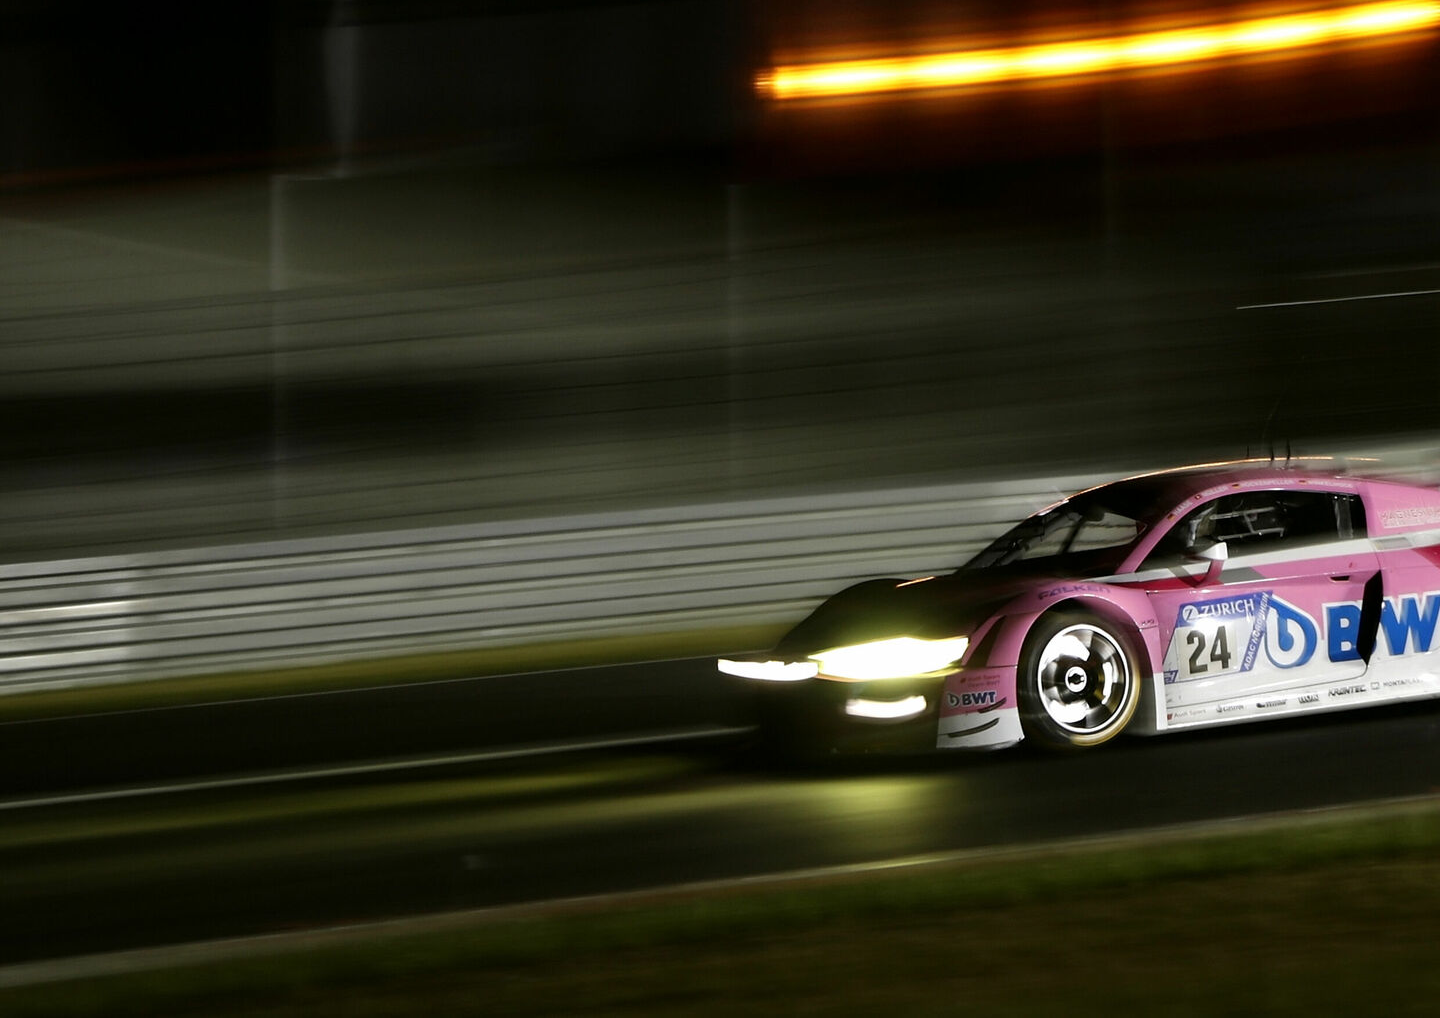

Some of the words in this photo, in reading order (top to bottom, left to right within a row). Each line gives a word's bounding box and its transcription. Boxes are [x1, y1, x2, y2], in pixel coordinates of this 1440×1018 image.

[1199, 598, 1254, 616] ZURICH
[1186, 625, 1232, 674] 24
[1243, 643, 1256, 670] ADAC
[961, 691, 996, 705] BWT
